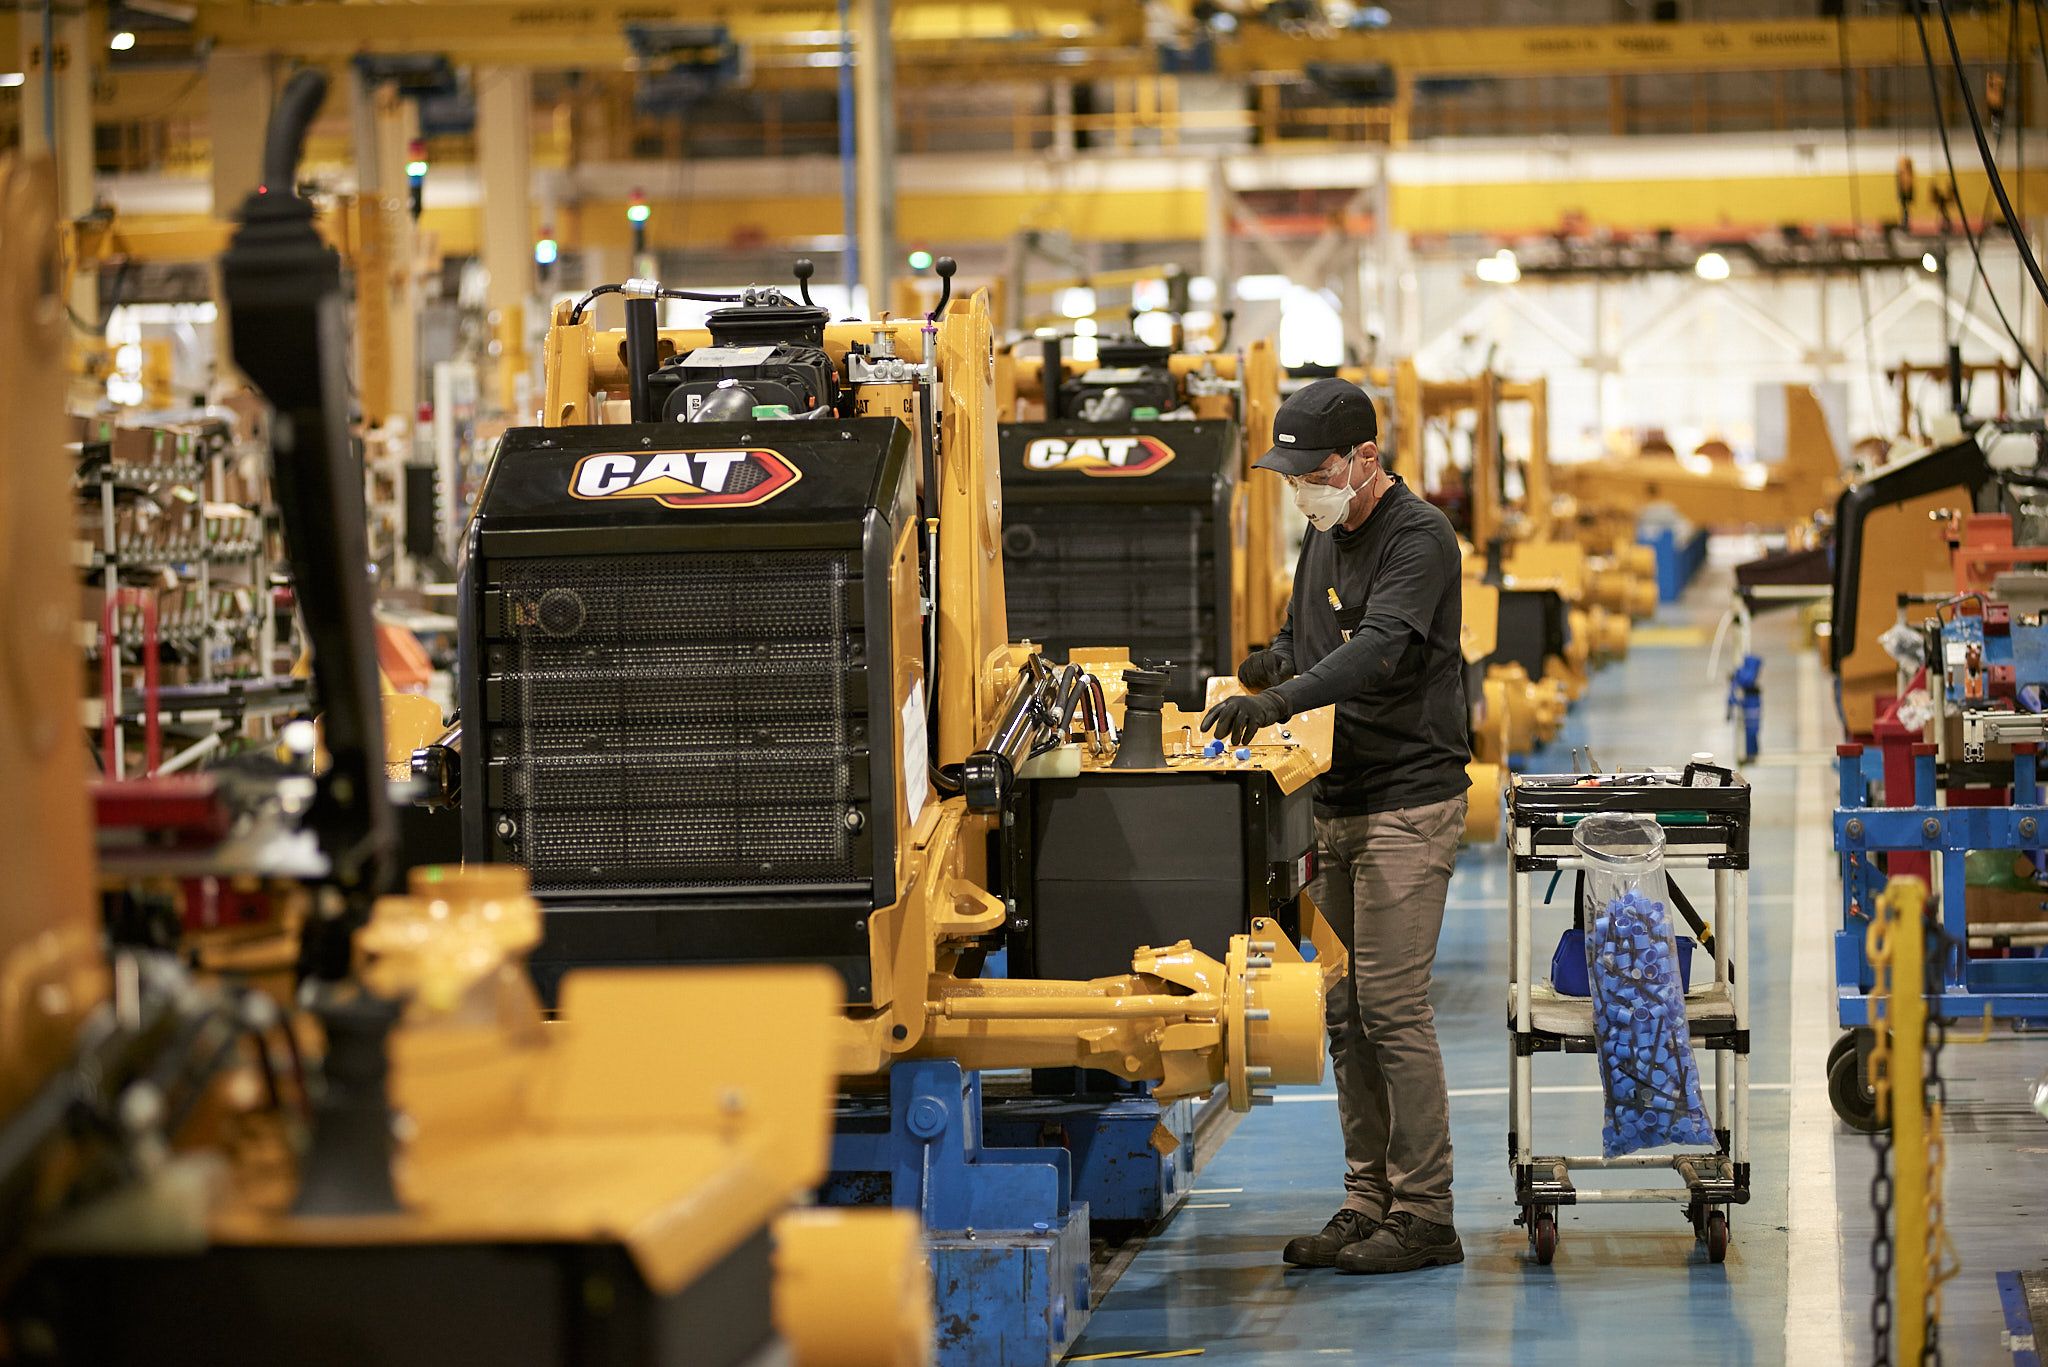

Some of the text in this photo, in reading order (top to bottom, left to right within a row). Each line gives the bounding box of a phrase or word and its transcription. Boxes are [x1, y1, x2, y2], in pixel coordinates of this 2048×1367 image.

[903, 398, 914, 413] CA
[1029, 438, 1139, 468] CAT
[577, 451, 747, 496] CAT
